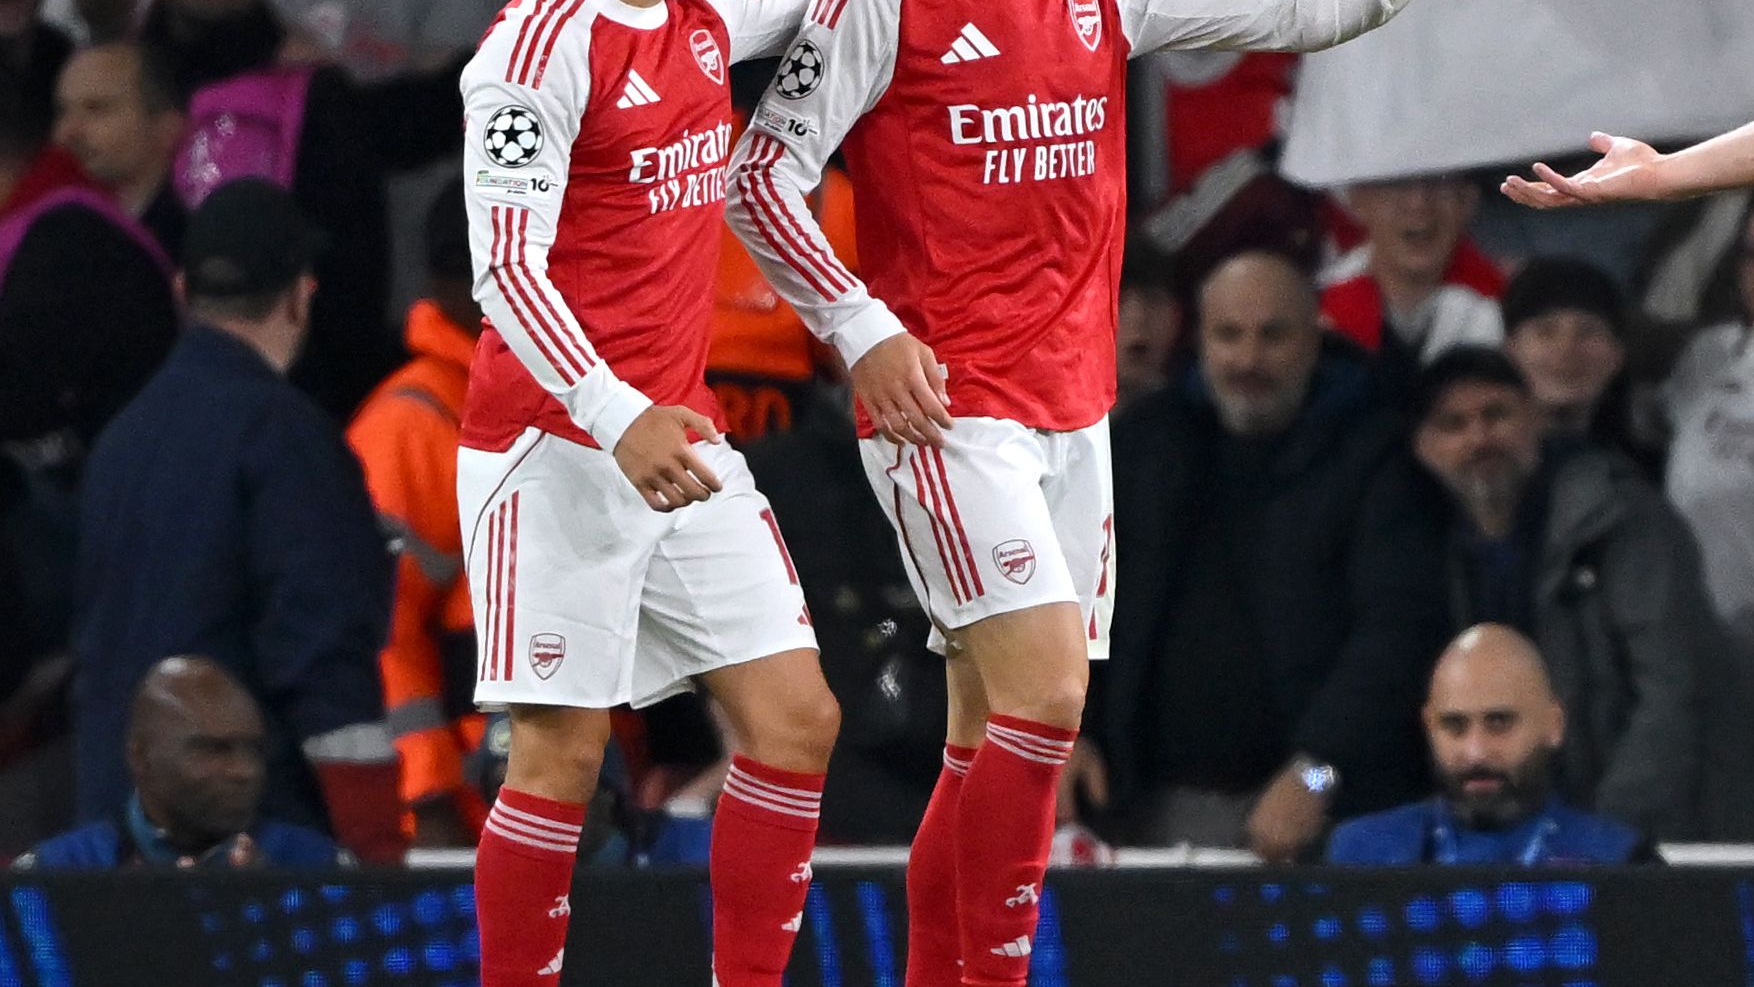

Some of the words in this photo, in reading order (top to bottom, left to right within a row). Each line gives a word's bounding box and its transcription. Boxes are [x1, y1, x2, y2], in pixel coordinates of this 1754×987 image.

[947, 93, 1108, 145] Emirates
[628, 119, 732, 184] Emirat
[983, 148, 1027, 185] FLY
[1033, 140, 1096, 181] BETTER
[681, 165, 727, 208] BETTE
